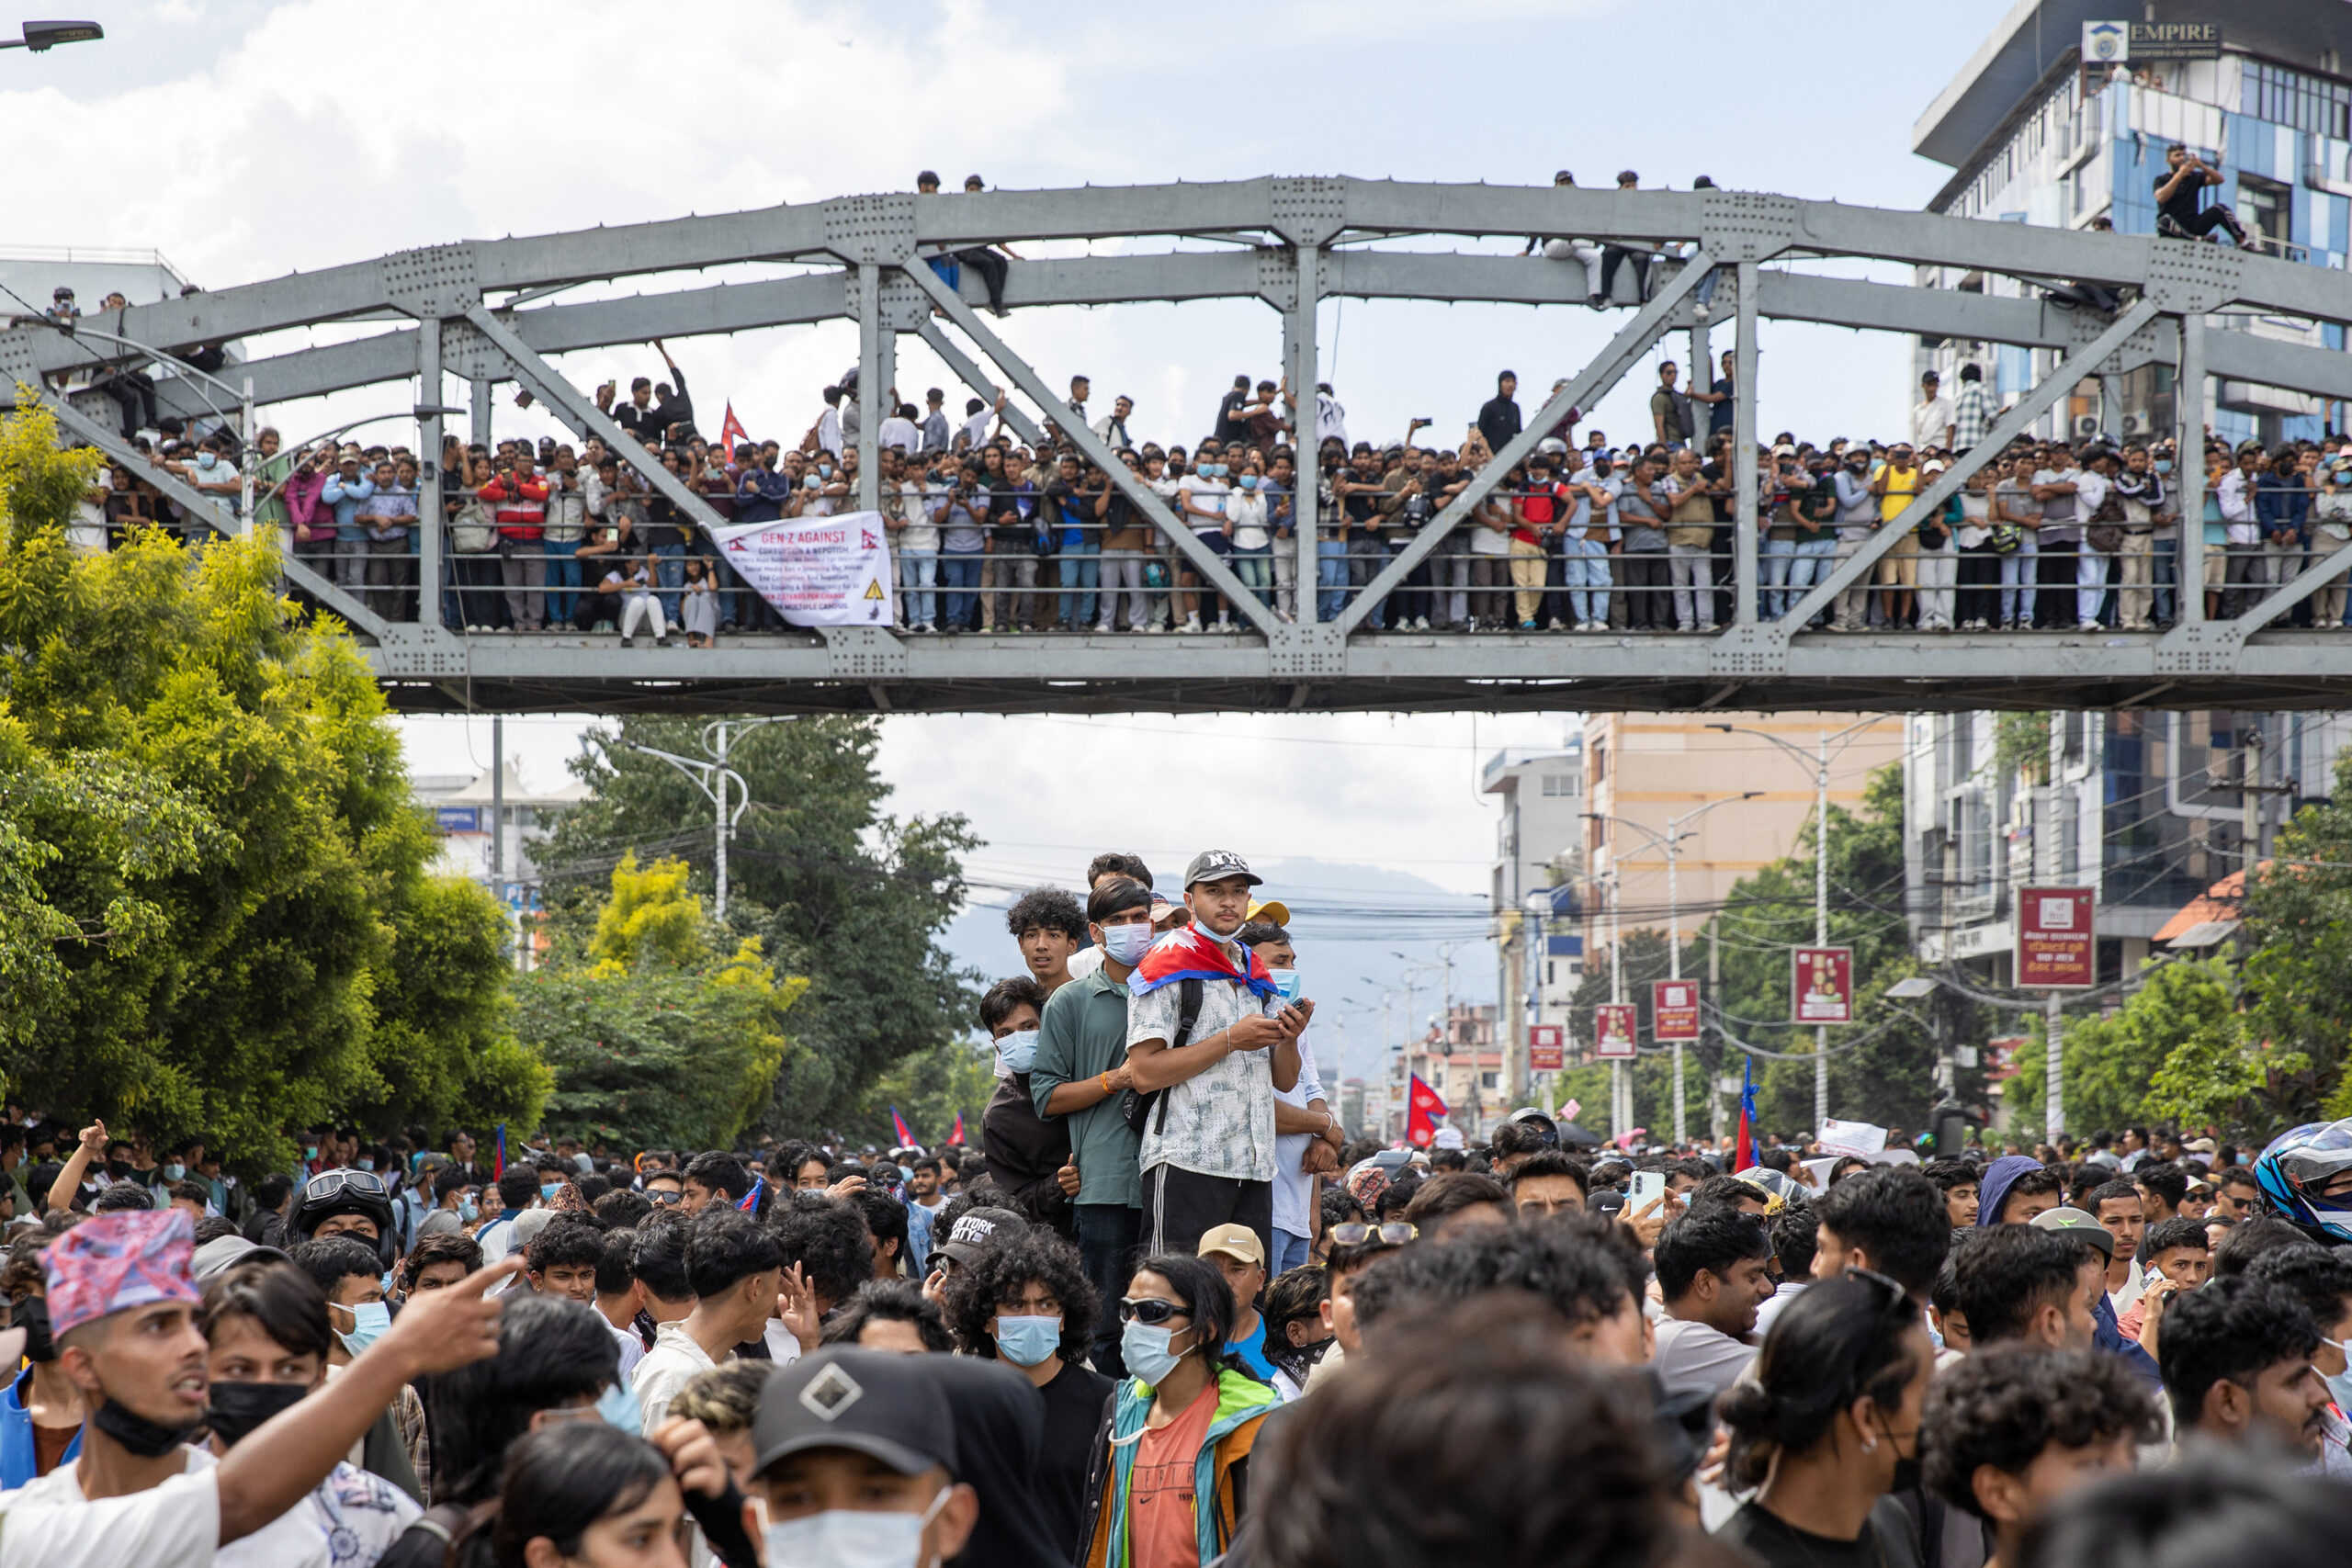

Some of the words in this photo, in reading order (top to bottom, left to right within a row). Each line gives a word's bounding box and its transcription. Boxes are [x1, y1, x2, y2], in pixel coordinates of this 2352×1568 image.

[2131, 23, 2218, 41] EMPIRE
[797, 530, 846, 543] AGAINST
[966, 1216, 996, 1235] YORK
